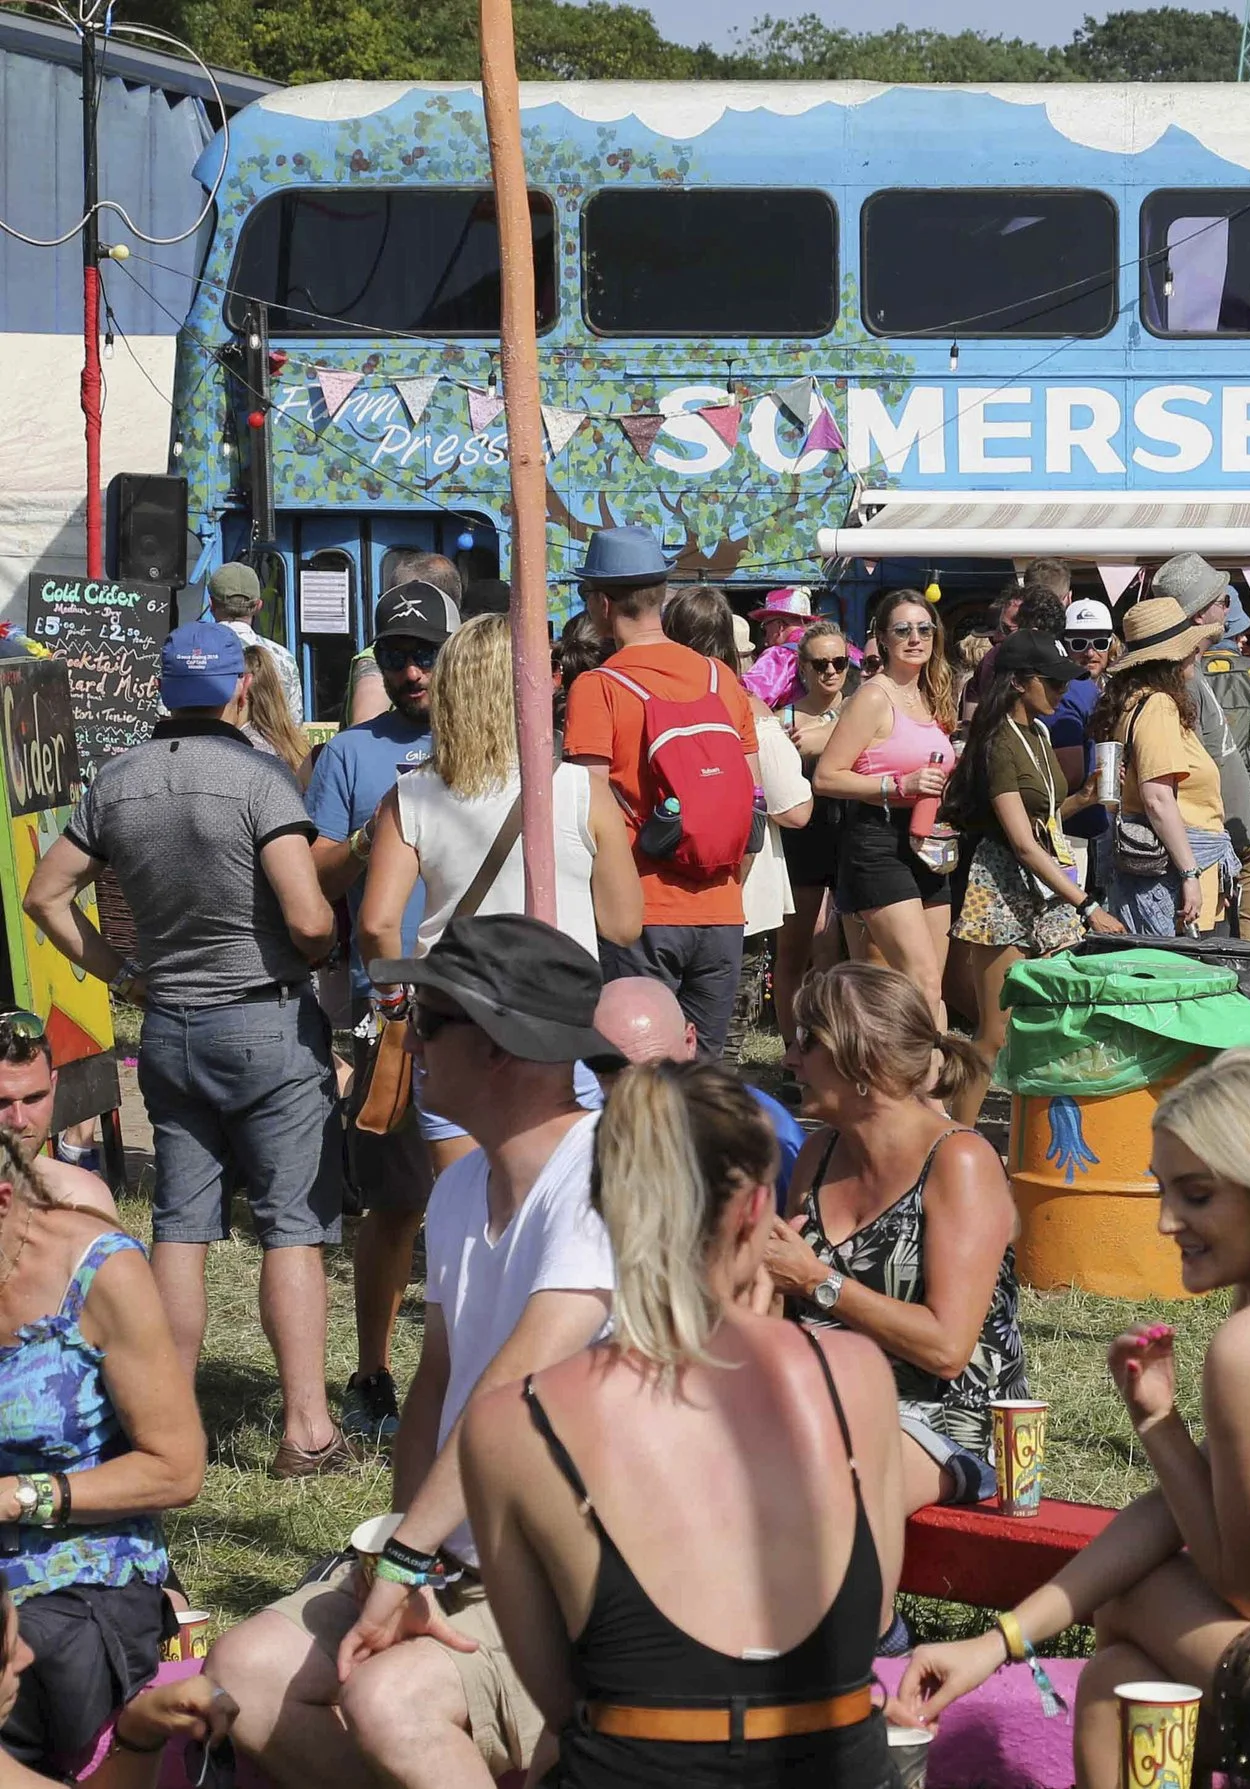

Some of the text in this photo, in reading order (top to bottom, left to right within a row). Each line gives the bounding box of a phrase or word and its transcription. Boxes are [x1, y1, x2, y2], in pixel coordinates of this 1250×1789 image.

[370, 423, 551, 466] Press
[41, 580, 169, 614] Cold Cider 6%
[53, 603, 92, 616] Medium
[101, 606, 122, 625] Dry
[113, 674, 156, 703] Mist
[4, 685, 66, 808] Cider
